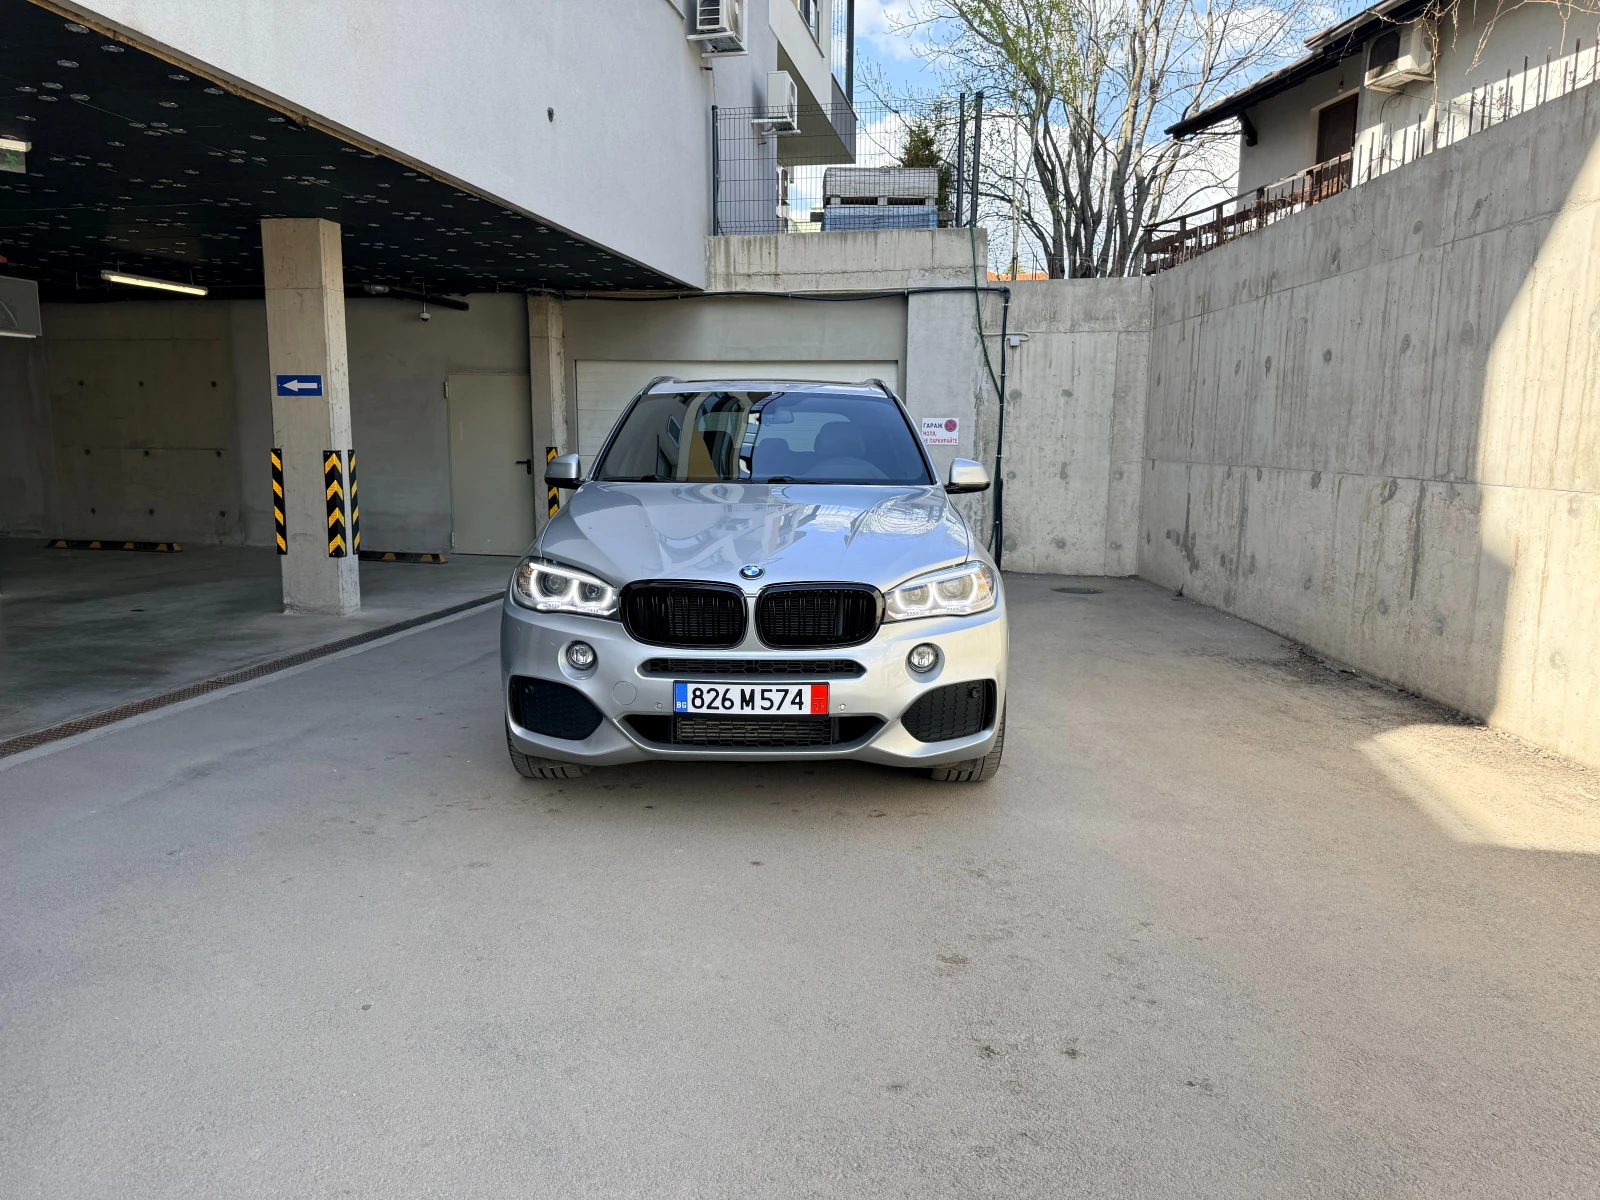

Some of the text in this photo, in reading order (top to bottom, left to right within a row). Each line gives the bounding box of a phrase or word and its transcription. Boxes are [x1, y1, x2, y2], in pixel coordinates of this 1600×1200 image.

[676, 701, 687, 709] BG
[691, 687, 804, 711] 826 M 574
